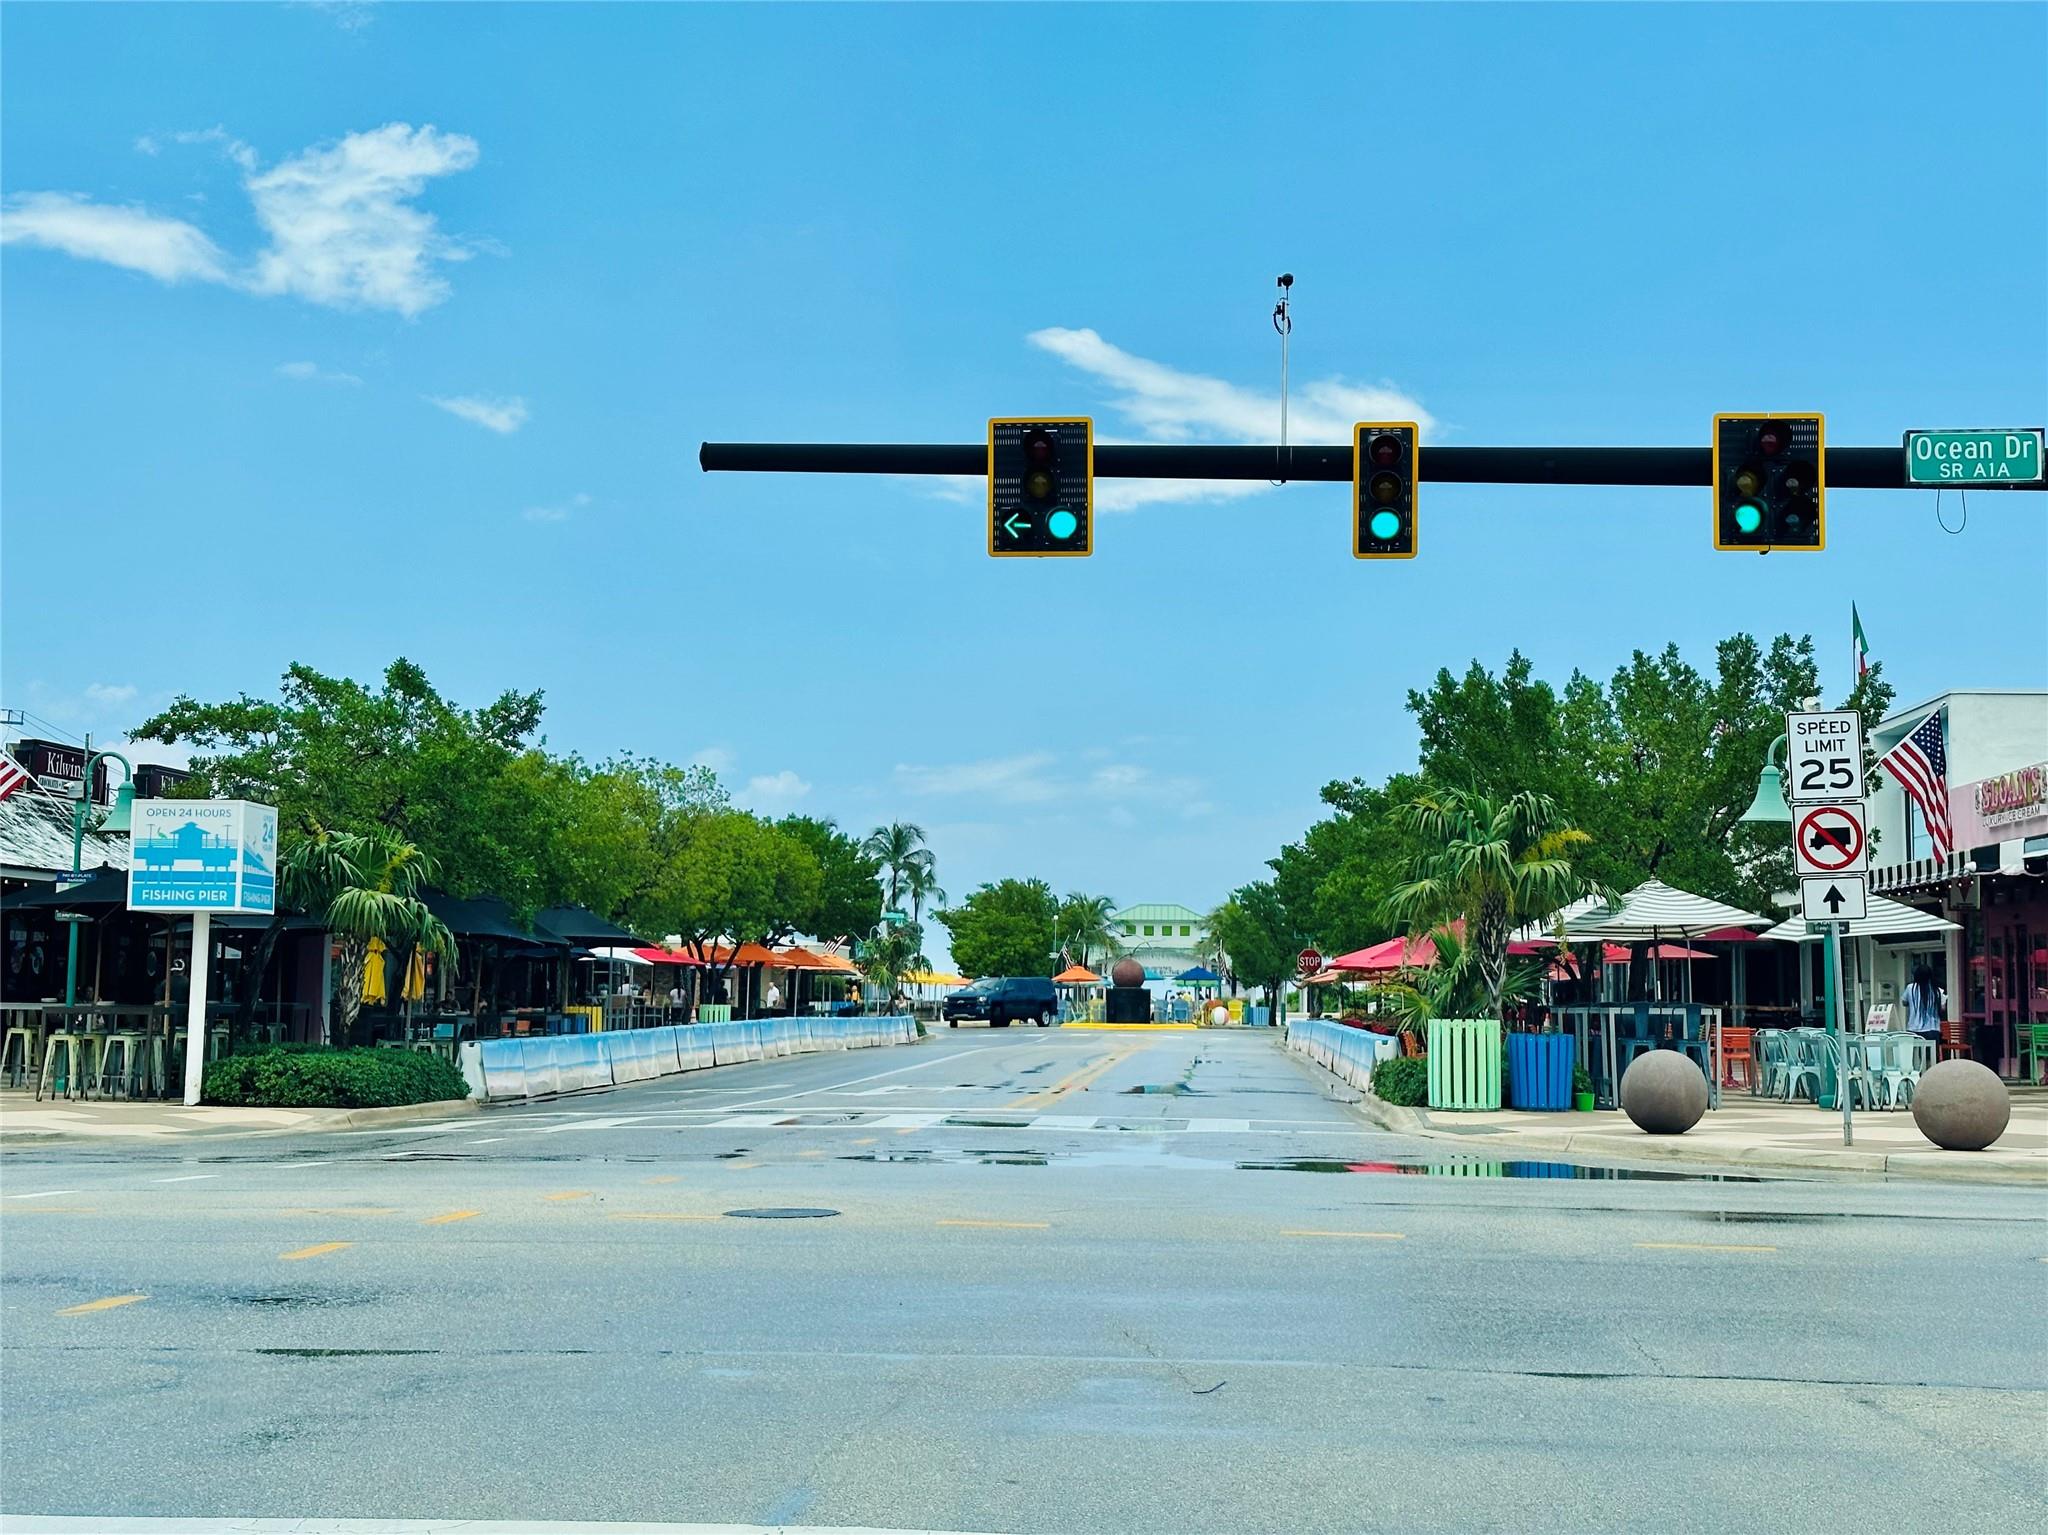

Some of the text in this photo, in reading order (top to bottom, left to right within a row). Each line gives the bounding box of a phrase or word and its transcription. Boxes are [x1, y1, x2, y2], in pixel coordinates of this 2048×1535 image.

[1916, 435, 2033, 460] Ocean Dr
[1940, 462, 2011, 478] SR A1A
[1797, 721, 1851, 735] SPEED
[1805, 739, 1846, 753] LIMIT
[47, 752, 85, 779] Kilwins
[1800, 758, 1854, 790] 25
[1982, 767, 2041, 813] SLOAN'S
[146, 808, 232, 818] OPEN 24 HOURS
[2017, 804, 2041, 820] CREAM
[262, 822, 274, 844] 24
[142, 889, 227, 901] FISHING PIER
[1299, 956, 1320, 967] STOP
